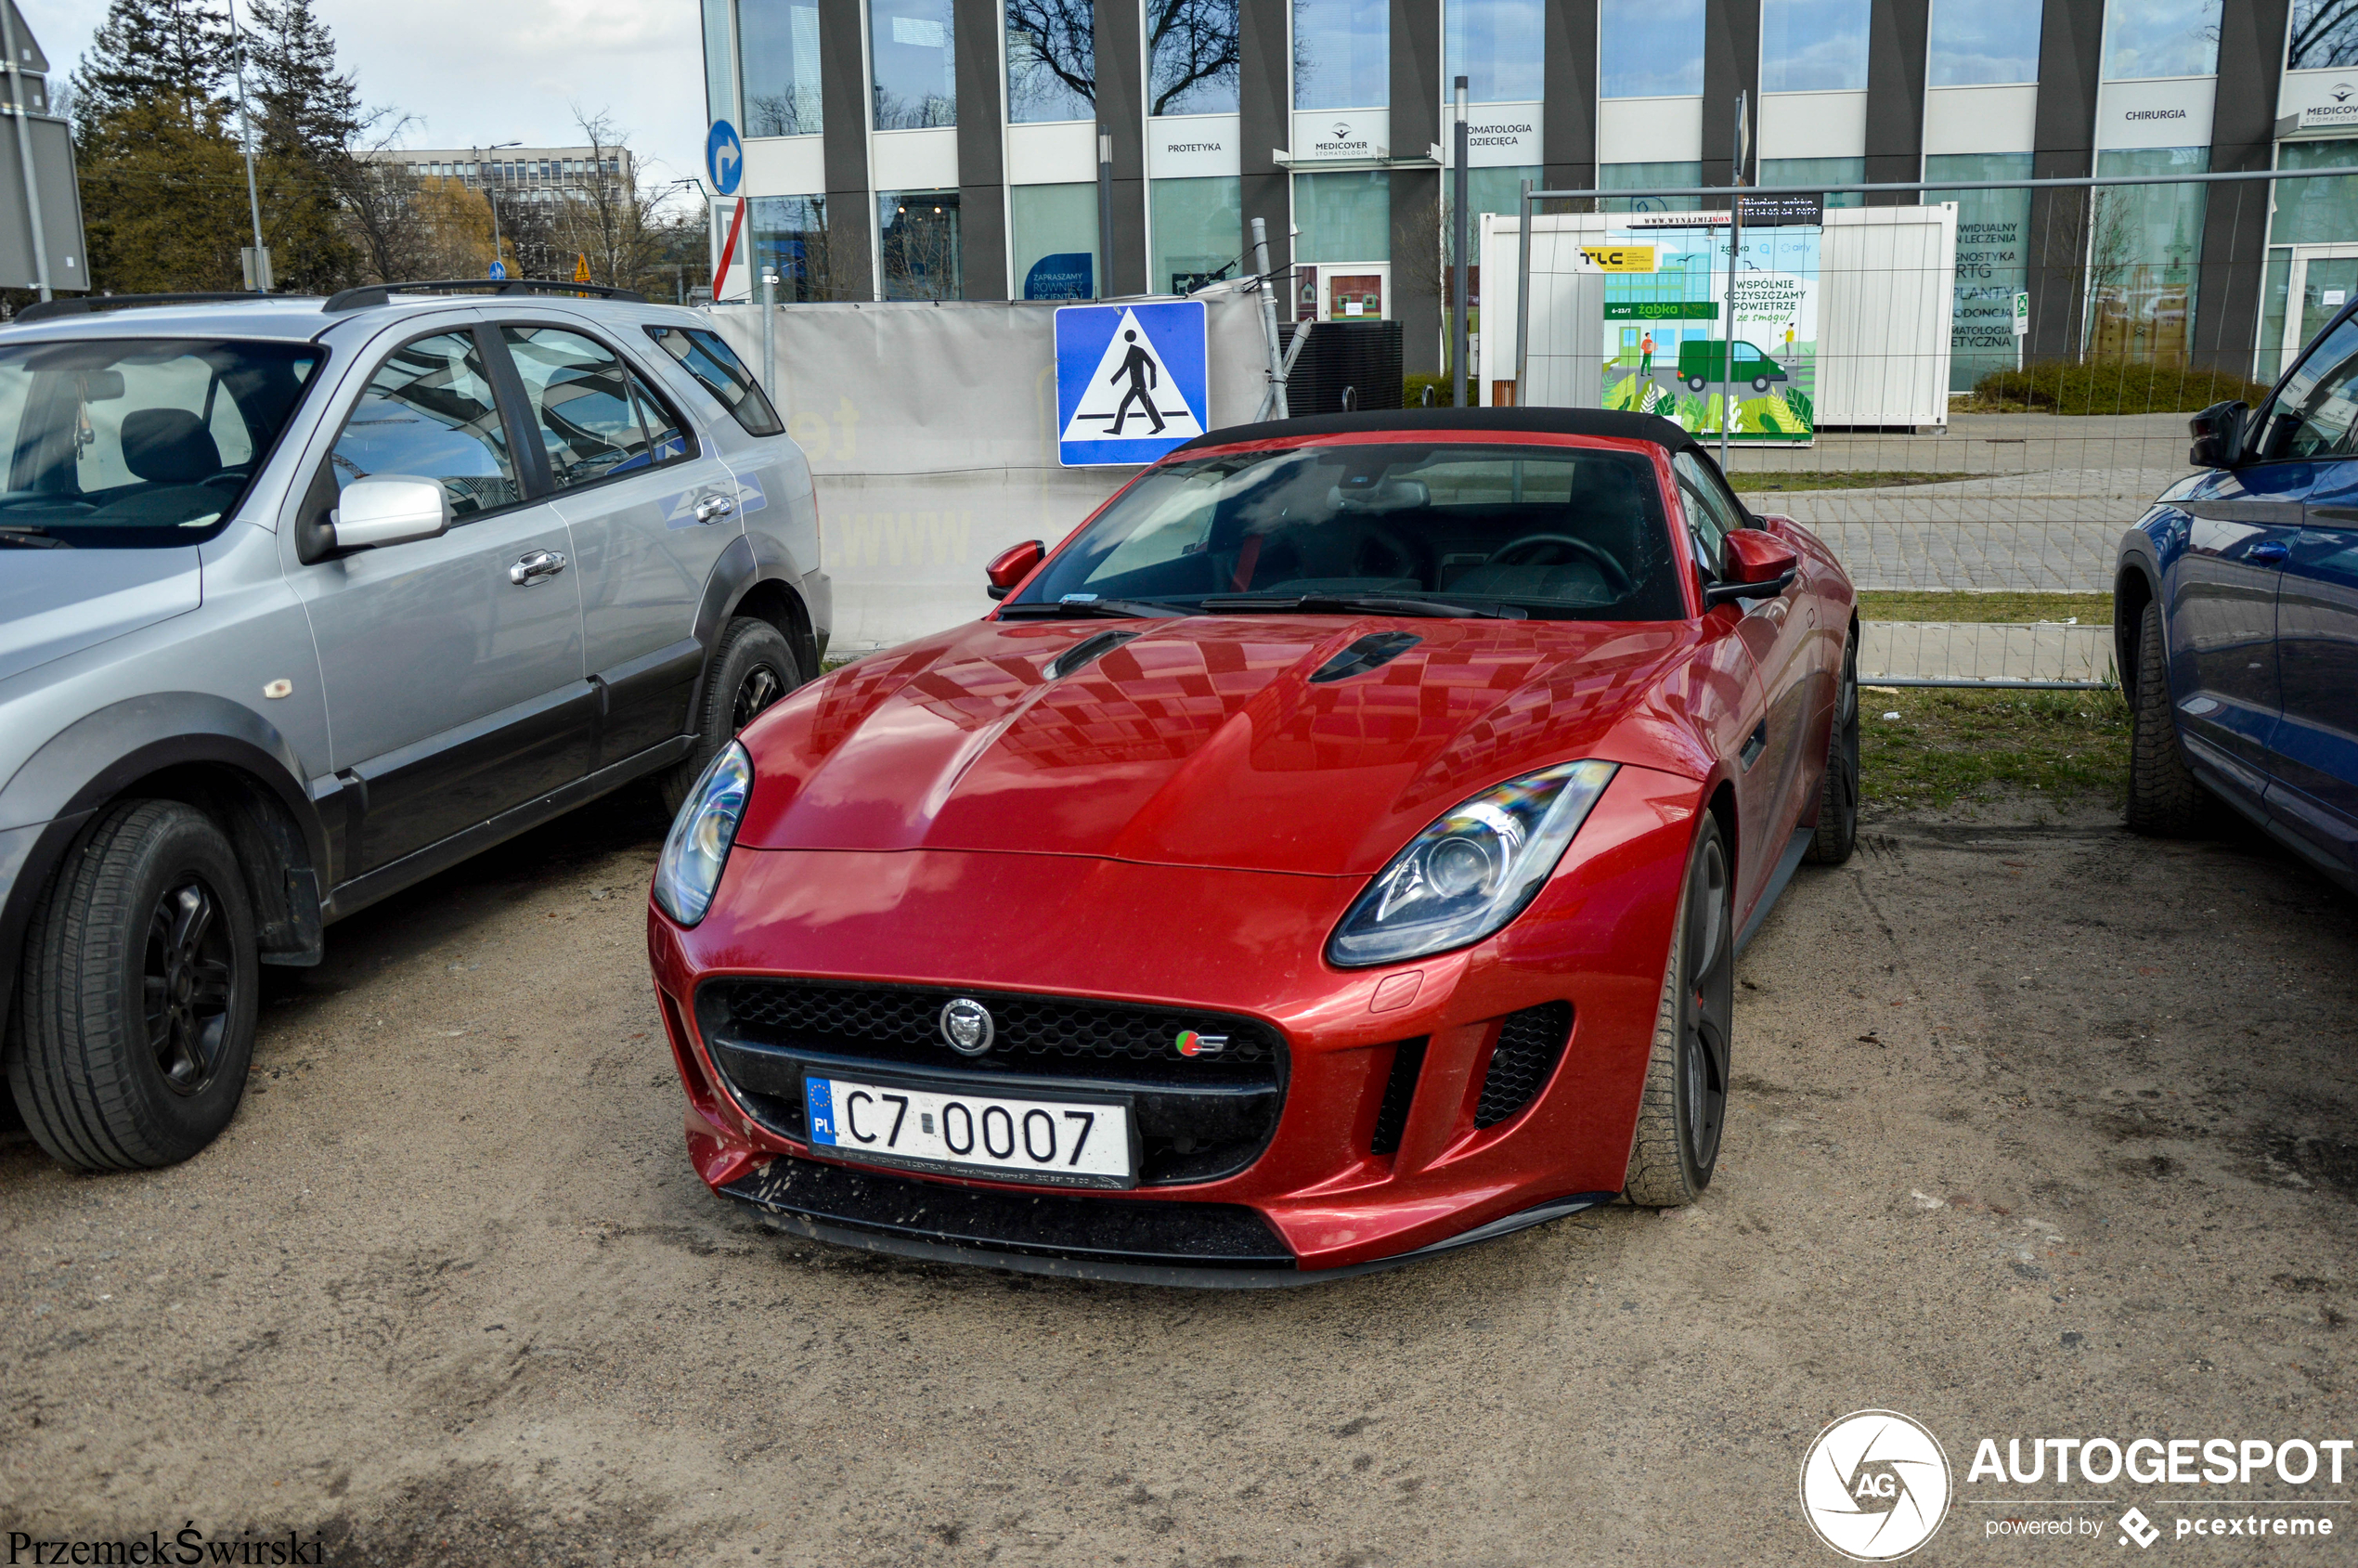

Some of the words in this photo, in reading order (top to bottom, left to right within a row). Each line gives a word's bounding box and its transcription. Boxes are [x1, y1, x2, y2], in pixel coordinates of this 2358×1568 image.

[2125, 109, 2186, 121] CHIRURGIA
[1315, 141, 1367, 150] MEDICOVER
[1470, 136, 1519, 147] DZIECIĘCA
[1168, 142, 1222, 153] PROTETYKA
[1644, 215, 1733, 225] WWW.WYNAJMIJKON
[1957, 223, 2017, 233] WIDUALNY
[1965, 234, 2016, 244] LECZENIA
[1580, 253, 1623, 265] TLC
[1033, 273, 1083, 281] ZAPRASZAMY
[1956, 264, 1991, 279] RTG
[1033, 279, 1083, 292] RÓWNIEŻ
[1735, 278, 1794, 289] WSPÓLNIE
[1638, 304, 1678, 315] żabka
[1732, 302, 1796, 311] POWIETRZE
[1736, 314, 1748, 322] ze
[1752, 311, 1793, 324] smogu!
[945, 1000, 987, 1017] JAGUAR
[814, 1117, 833, 1134] PL
[847, 1090, 909, 1147] C7
[942, 1101, 1095, 1166] 0007
